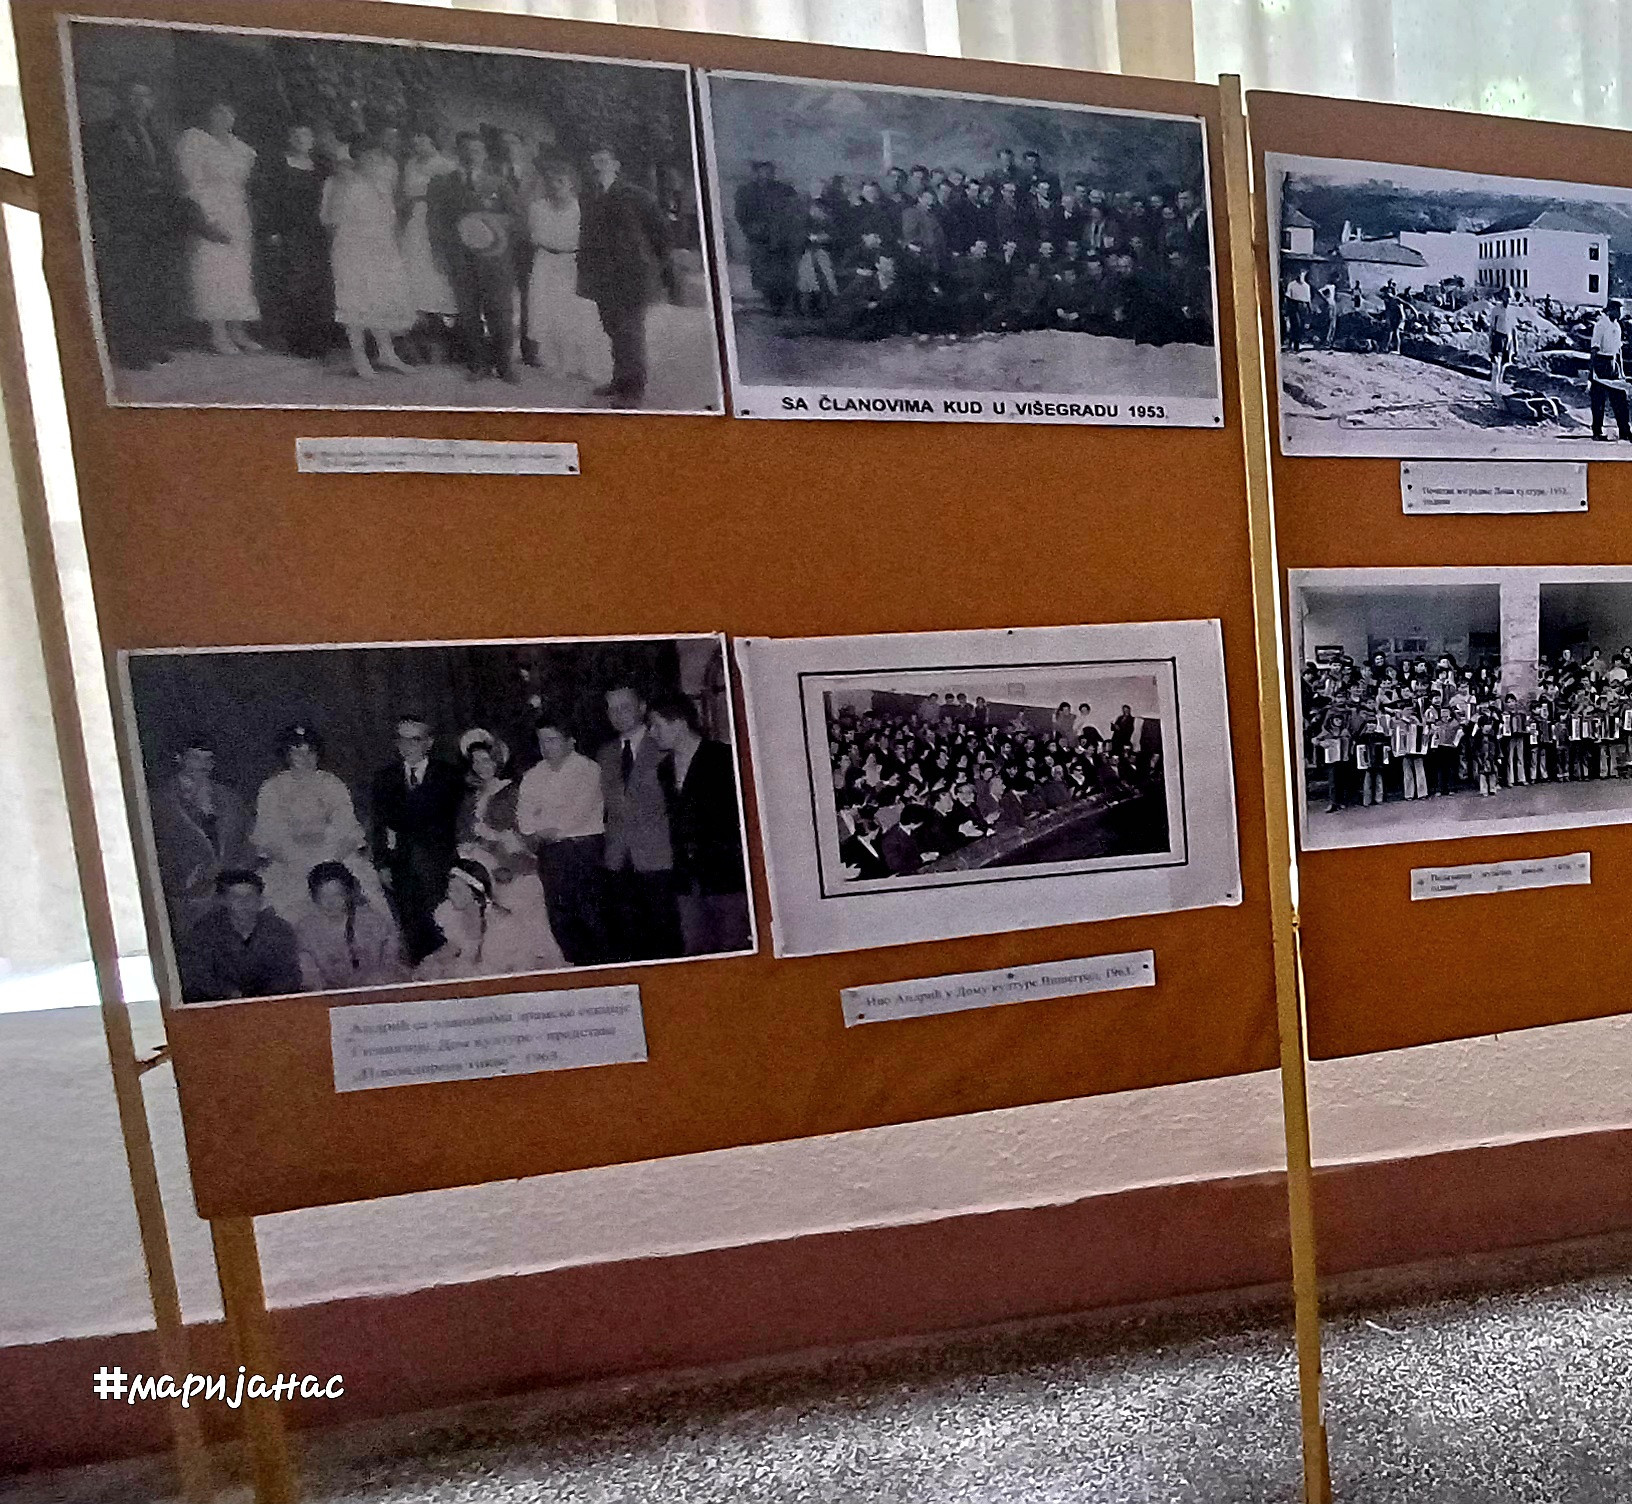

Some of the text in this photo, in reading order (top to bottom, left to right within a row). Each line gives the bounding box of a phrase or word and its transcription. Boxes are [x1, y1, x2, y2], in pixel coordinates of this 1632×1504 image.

[781, 396, 808, 411] SA
[819, 394, 934, 413] ČLANOVIMA
[943, 400, 983, 414] KUD
[993, 401, 1006, 415] U
[1015, 401, 1118, 418] VIŠEGRADU
[991, 978, 1037, 993] кутуре
